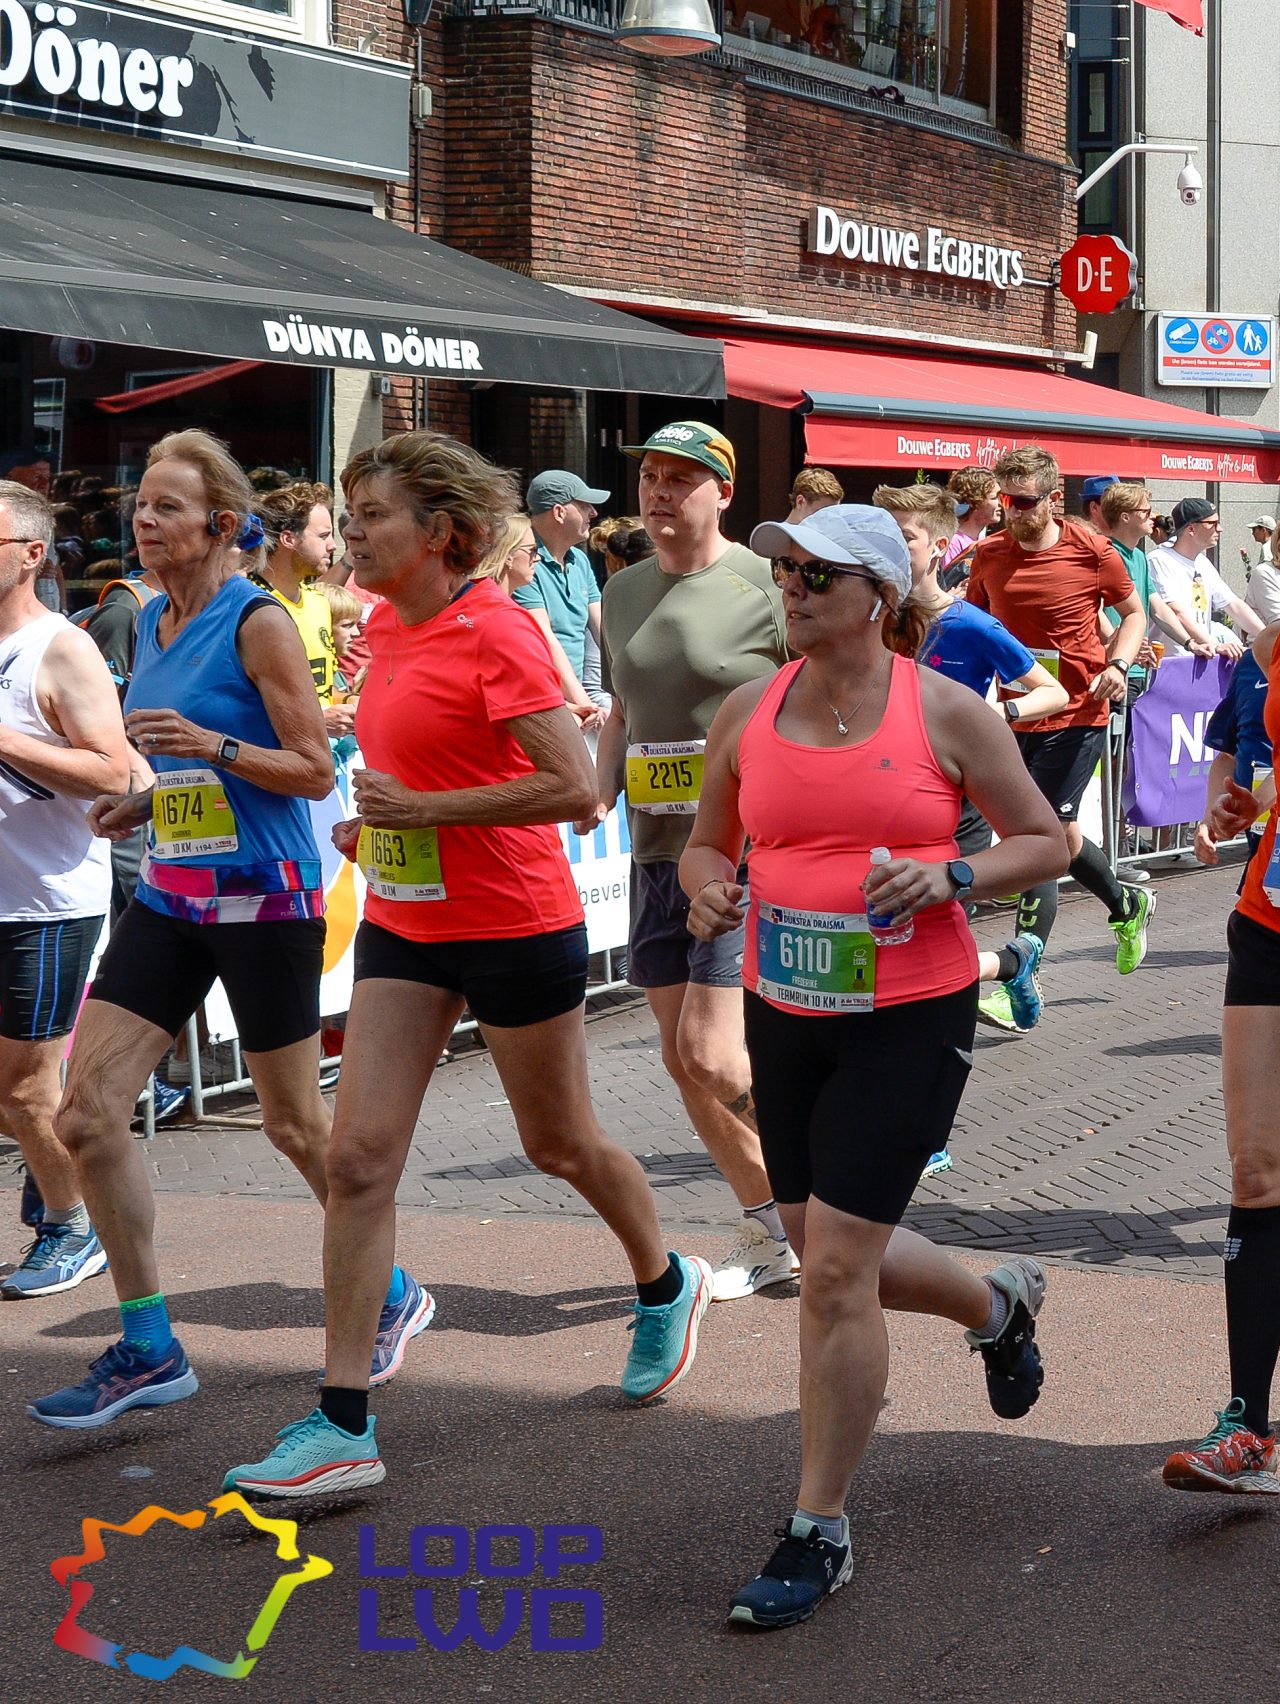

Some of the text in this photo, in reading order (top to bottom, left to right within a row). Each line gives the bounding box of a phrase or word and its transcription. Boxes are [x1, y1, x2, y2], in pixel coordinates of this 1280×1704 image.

[0, 0, 194, 118] Döner
[816, 205, 1024, 290] Douwe EGBERTS
[262, 313, 484, 371] DÜNYA DÖNER
[897, 436, 934, 455] Douwe
[934, 438, 971, 459] EGBERTS
[1161, 453, 1187, 470] Douwe
[1187, 455, 1214, 472] EGBERTS
[647, 760, 693, 790] 2215
[160, 791, 204, 826] 1674
[181, 842, 192, 853] KM
[370, 830, 407, 868] 1663
[813, 917, 846, 930] DRAISMA
[779, 931, 832, 974] 6110
[791, 975, 819, 989] FREDERIKE
[776, 987, 811, 1007] TEAMRUN
[811, 995, 820, 1008] 10
[822, 995, 836, 1009] KM
